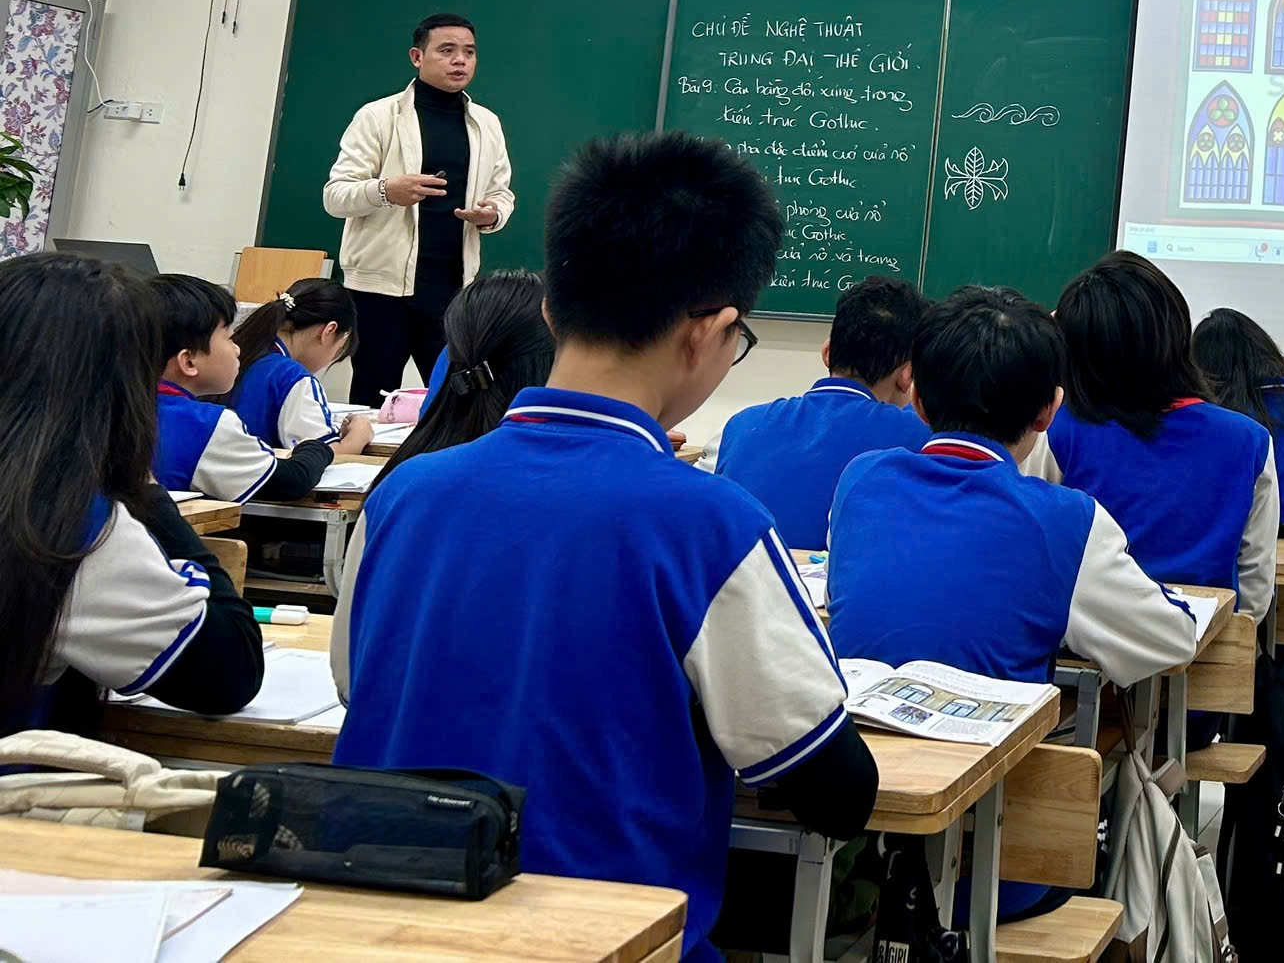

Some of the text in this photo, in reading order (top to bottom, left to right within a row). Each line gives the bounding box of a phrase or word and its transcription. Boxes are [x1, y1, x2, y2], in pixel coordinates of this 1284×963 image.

[765, 17, 808, 42] NGHỆ
[812, 15, 864, 42] THUẬT
[718, 51, 774, 67] TRUNG
[782, 49, 814, 74] ĐẠI
[861, 85, 913, 112] trong
